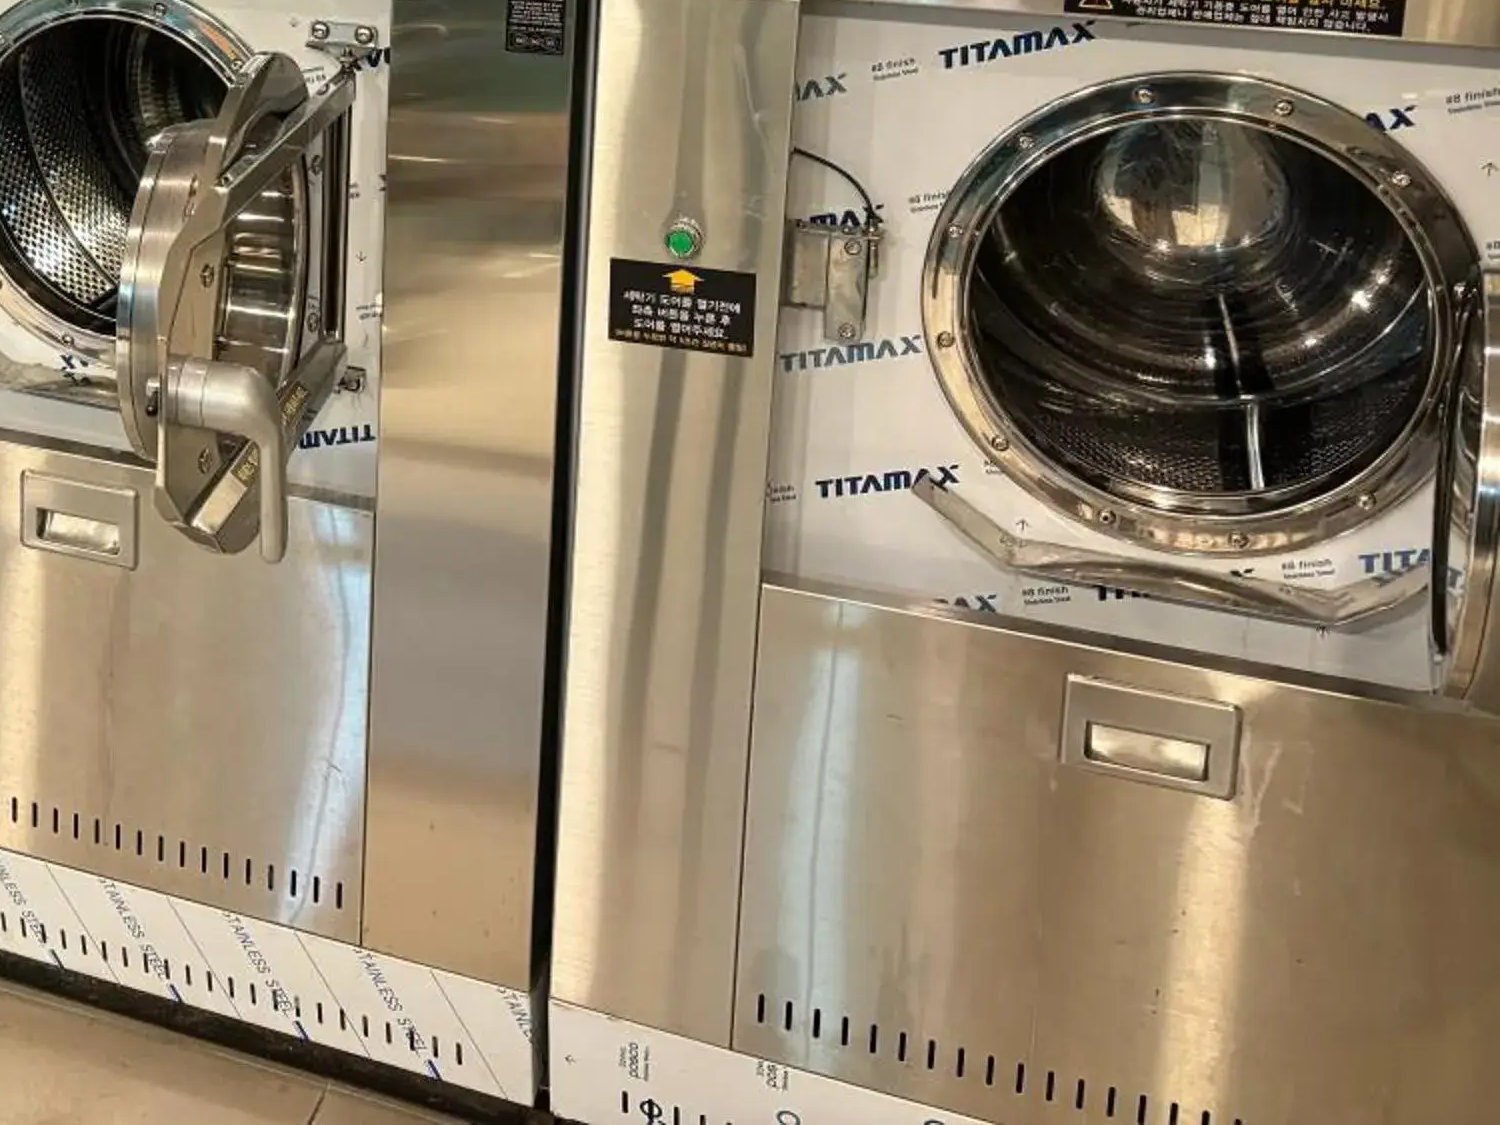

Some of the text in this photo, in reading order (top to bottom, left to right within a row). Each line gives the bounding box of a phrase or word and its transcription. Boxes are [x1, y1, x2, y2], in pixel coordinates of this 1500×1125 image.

[938, 21, 1097, 70] TITAMAX
[623, 290, 741, 314] 세탁기 도어를 열기전에
[633, 318, 666, 332] 도어를
[657, 307, 689, 322] 버튼을
[693, 312, 715, 325] 누른
[720, 315, 731, 326] 후
[780, 333, 923, 373] TITAMAX
